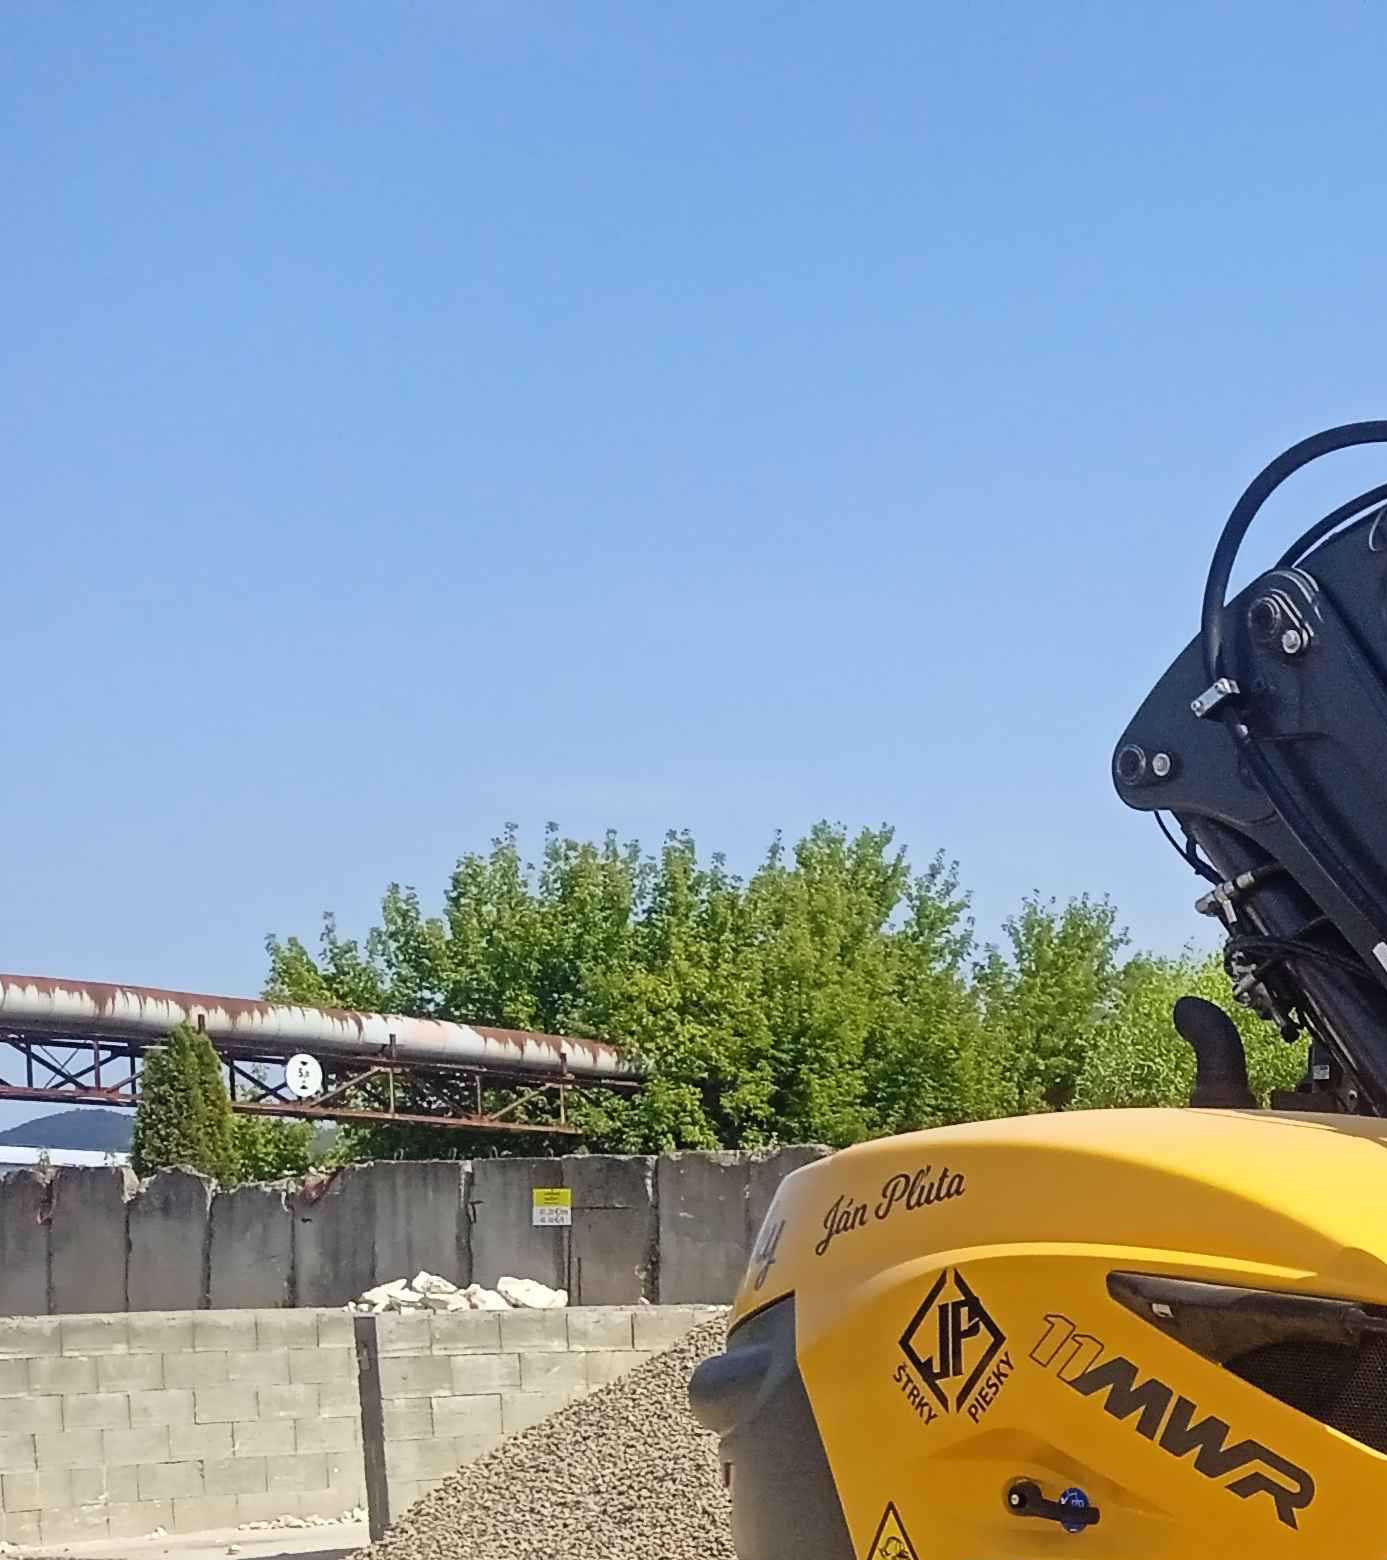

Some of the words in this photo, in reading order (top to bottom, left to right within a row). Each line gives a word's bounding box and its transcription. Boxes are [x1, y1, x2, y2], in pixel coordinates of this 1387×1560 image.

[815, 1194, 868, 1256] Ján
[892, 1361, 939, 1426] ŠTRKY
[967, 1351, 1015, 1424] PIESKY
